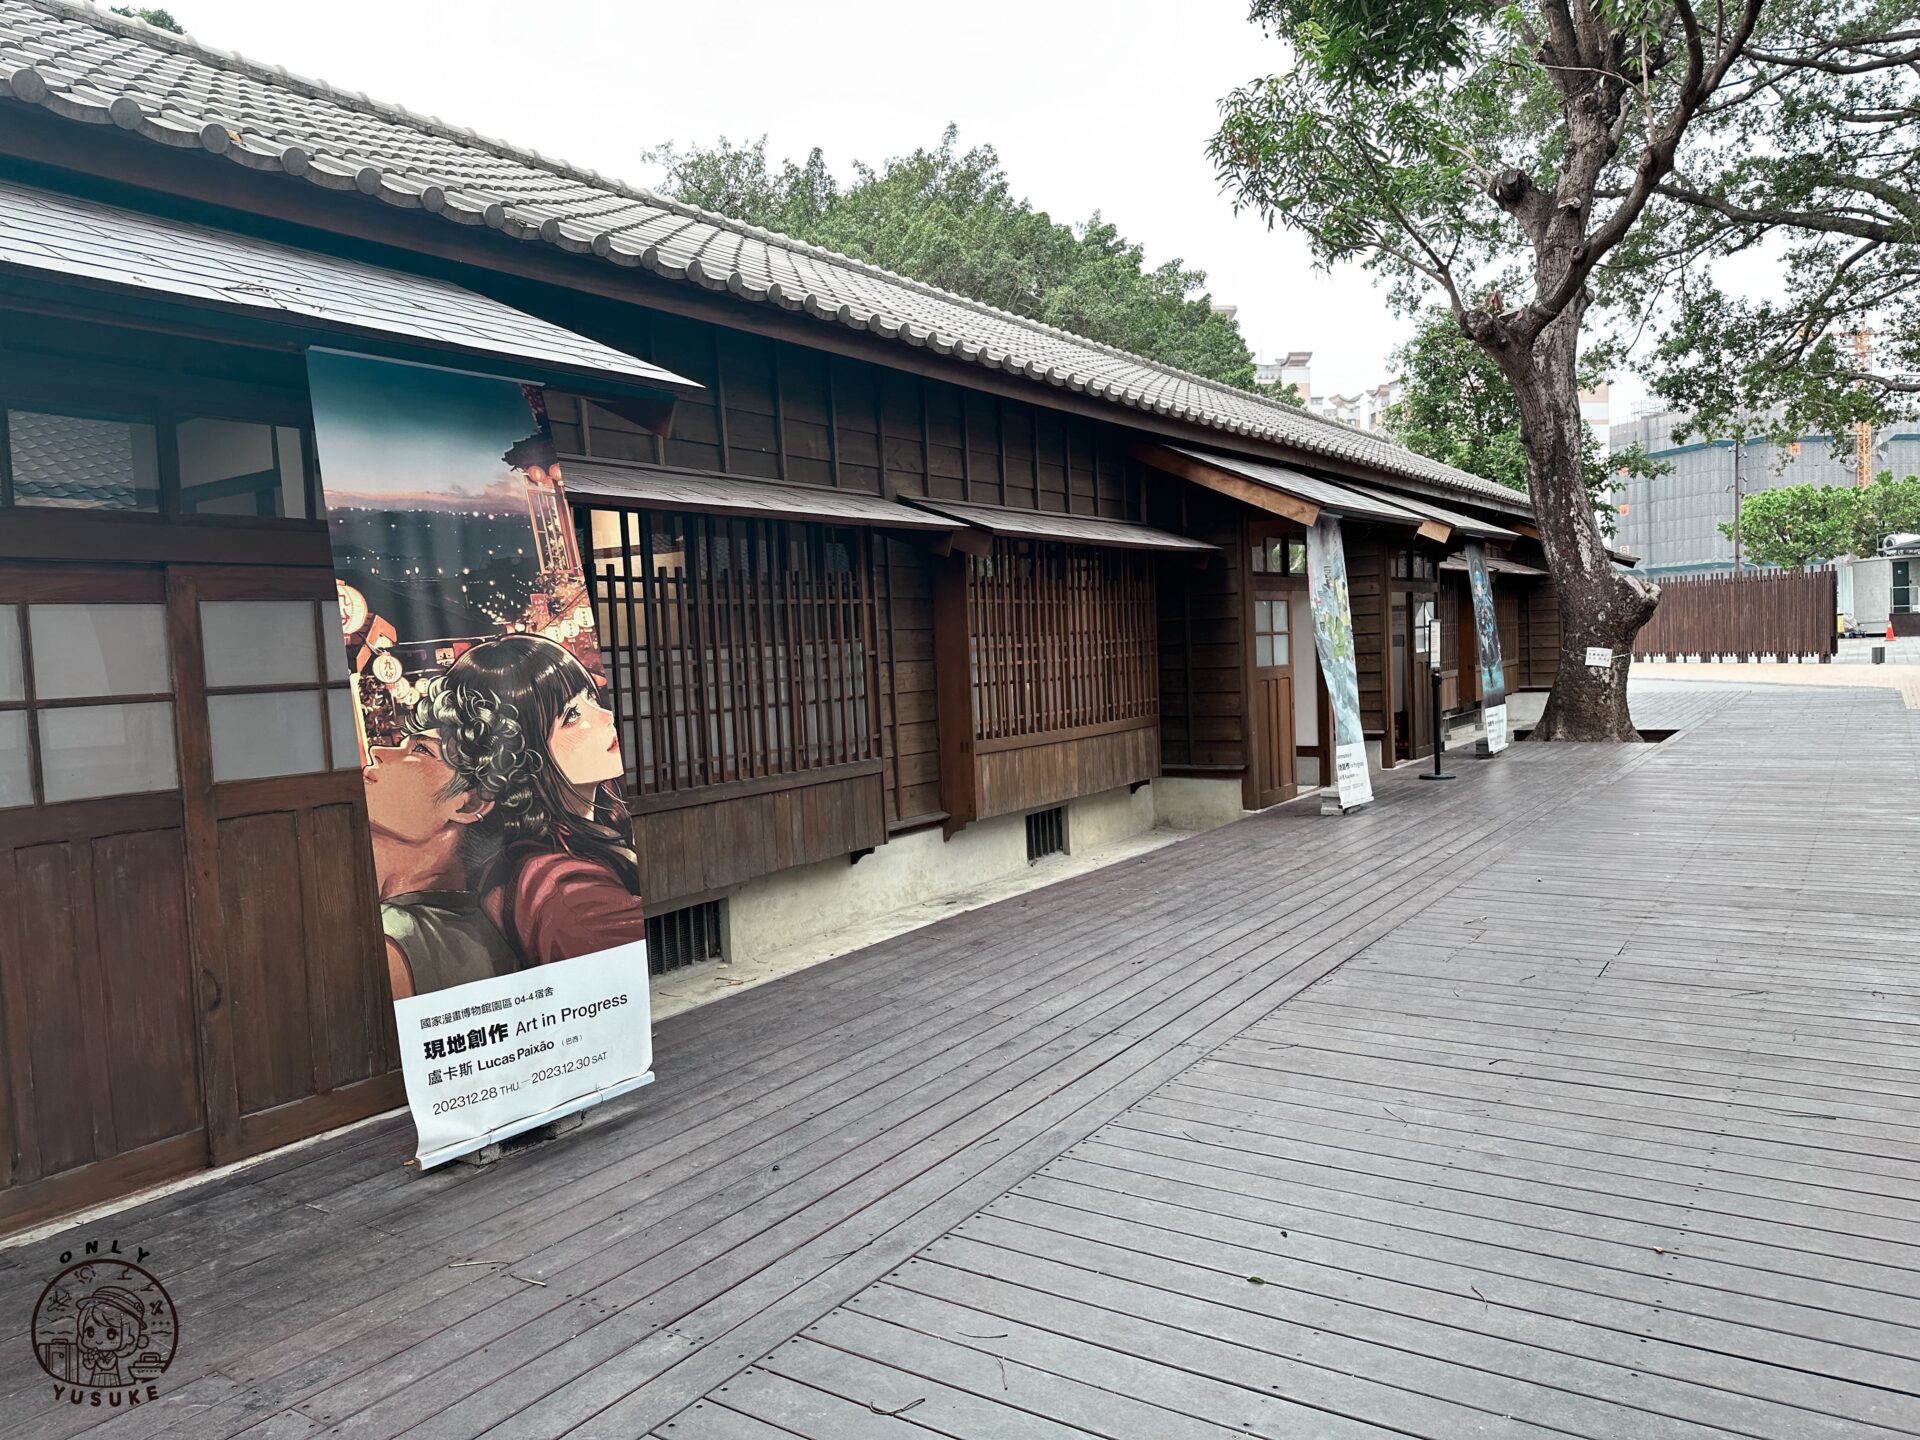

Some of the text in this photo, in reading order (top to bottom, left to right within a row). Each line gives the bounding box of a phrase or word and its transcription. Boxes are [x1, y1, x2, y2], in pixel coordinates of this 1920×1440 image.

[420, 997, 513, 1030] 國家漫畫博物館園區
[423, 994, 628, 1060] 現地創作 Art in Progress
[428, 1060, 473, 1086] 盧卡斯
[477, 1053, 516, 1071] Lucas
[517, 1040, 555, 1060] Paixão
[531, 1056, 591, 1084] 2023.12.30
